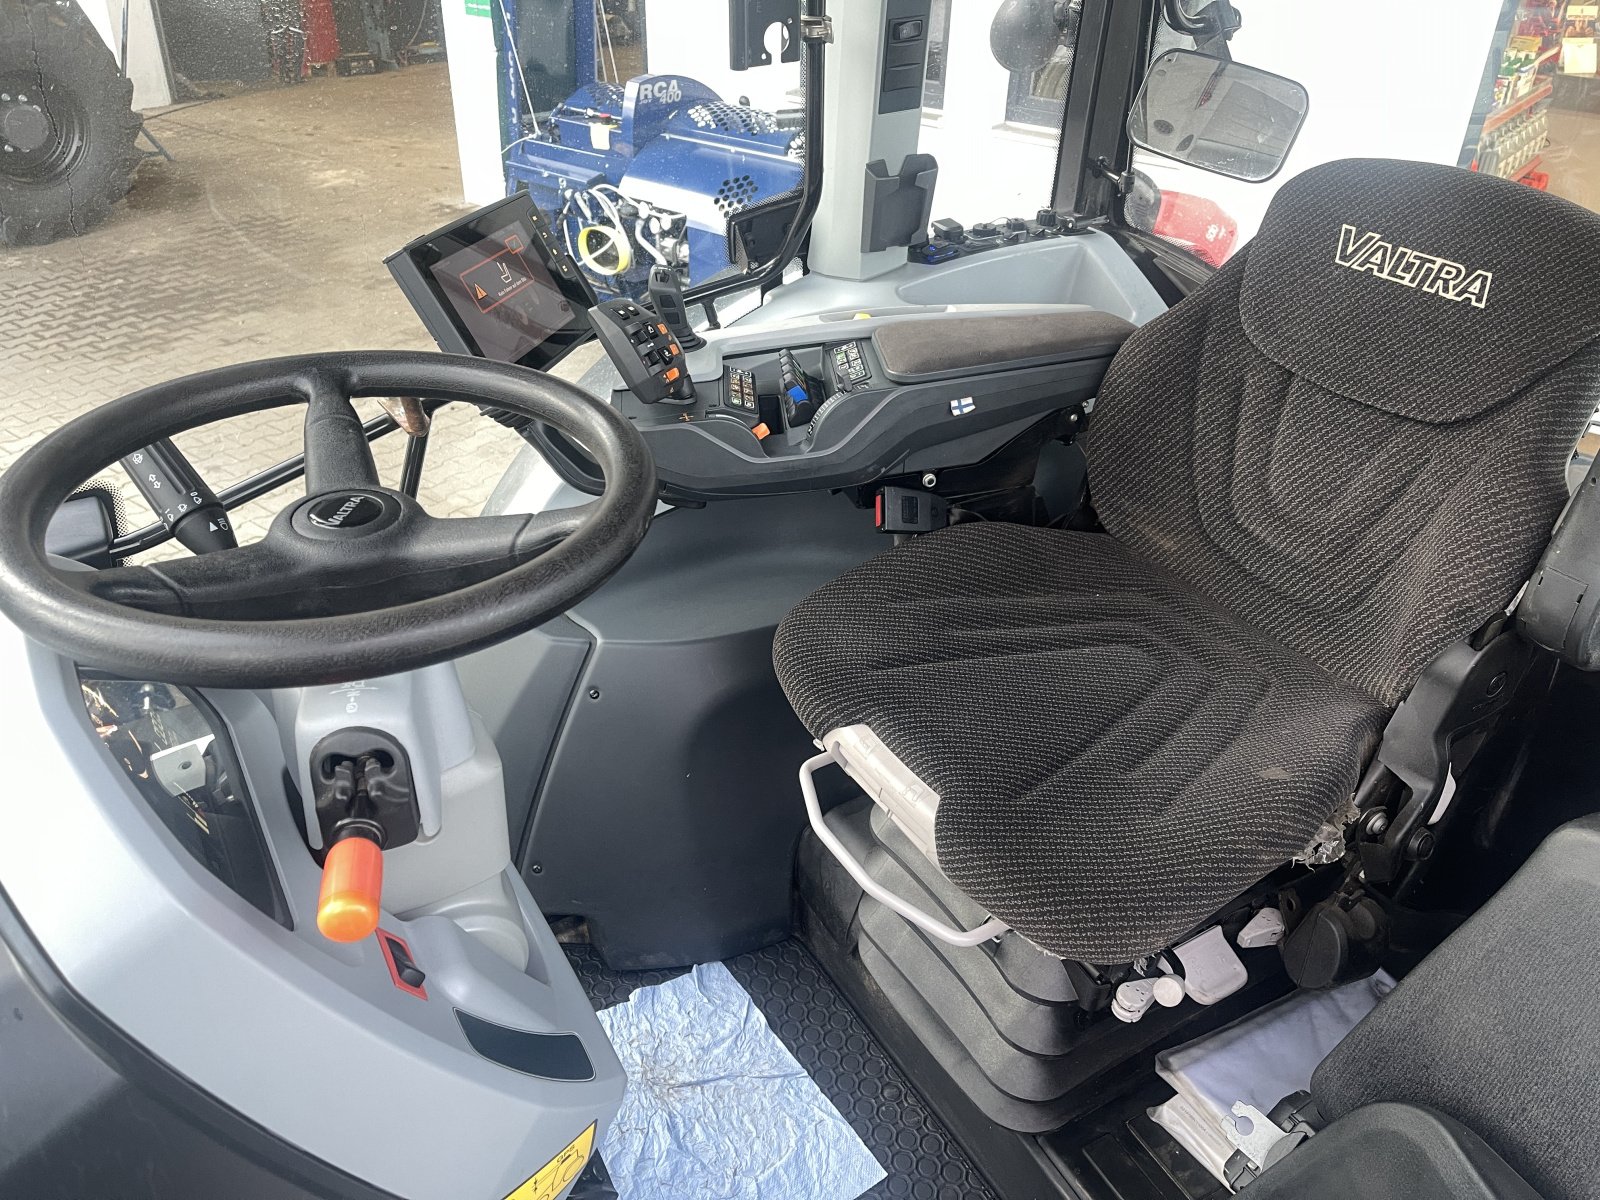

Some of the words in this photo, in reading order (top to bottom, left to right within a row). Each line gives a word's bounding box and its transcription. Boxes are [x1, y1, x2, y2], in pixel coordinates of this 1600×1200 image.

[640, 80, 679, 101] RCA
[660, 90, 682, 104] 400
[1335, 224, 1493, 309] VALTRA
[326, 496, 365, 527] VALTRA
